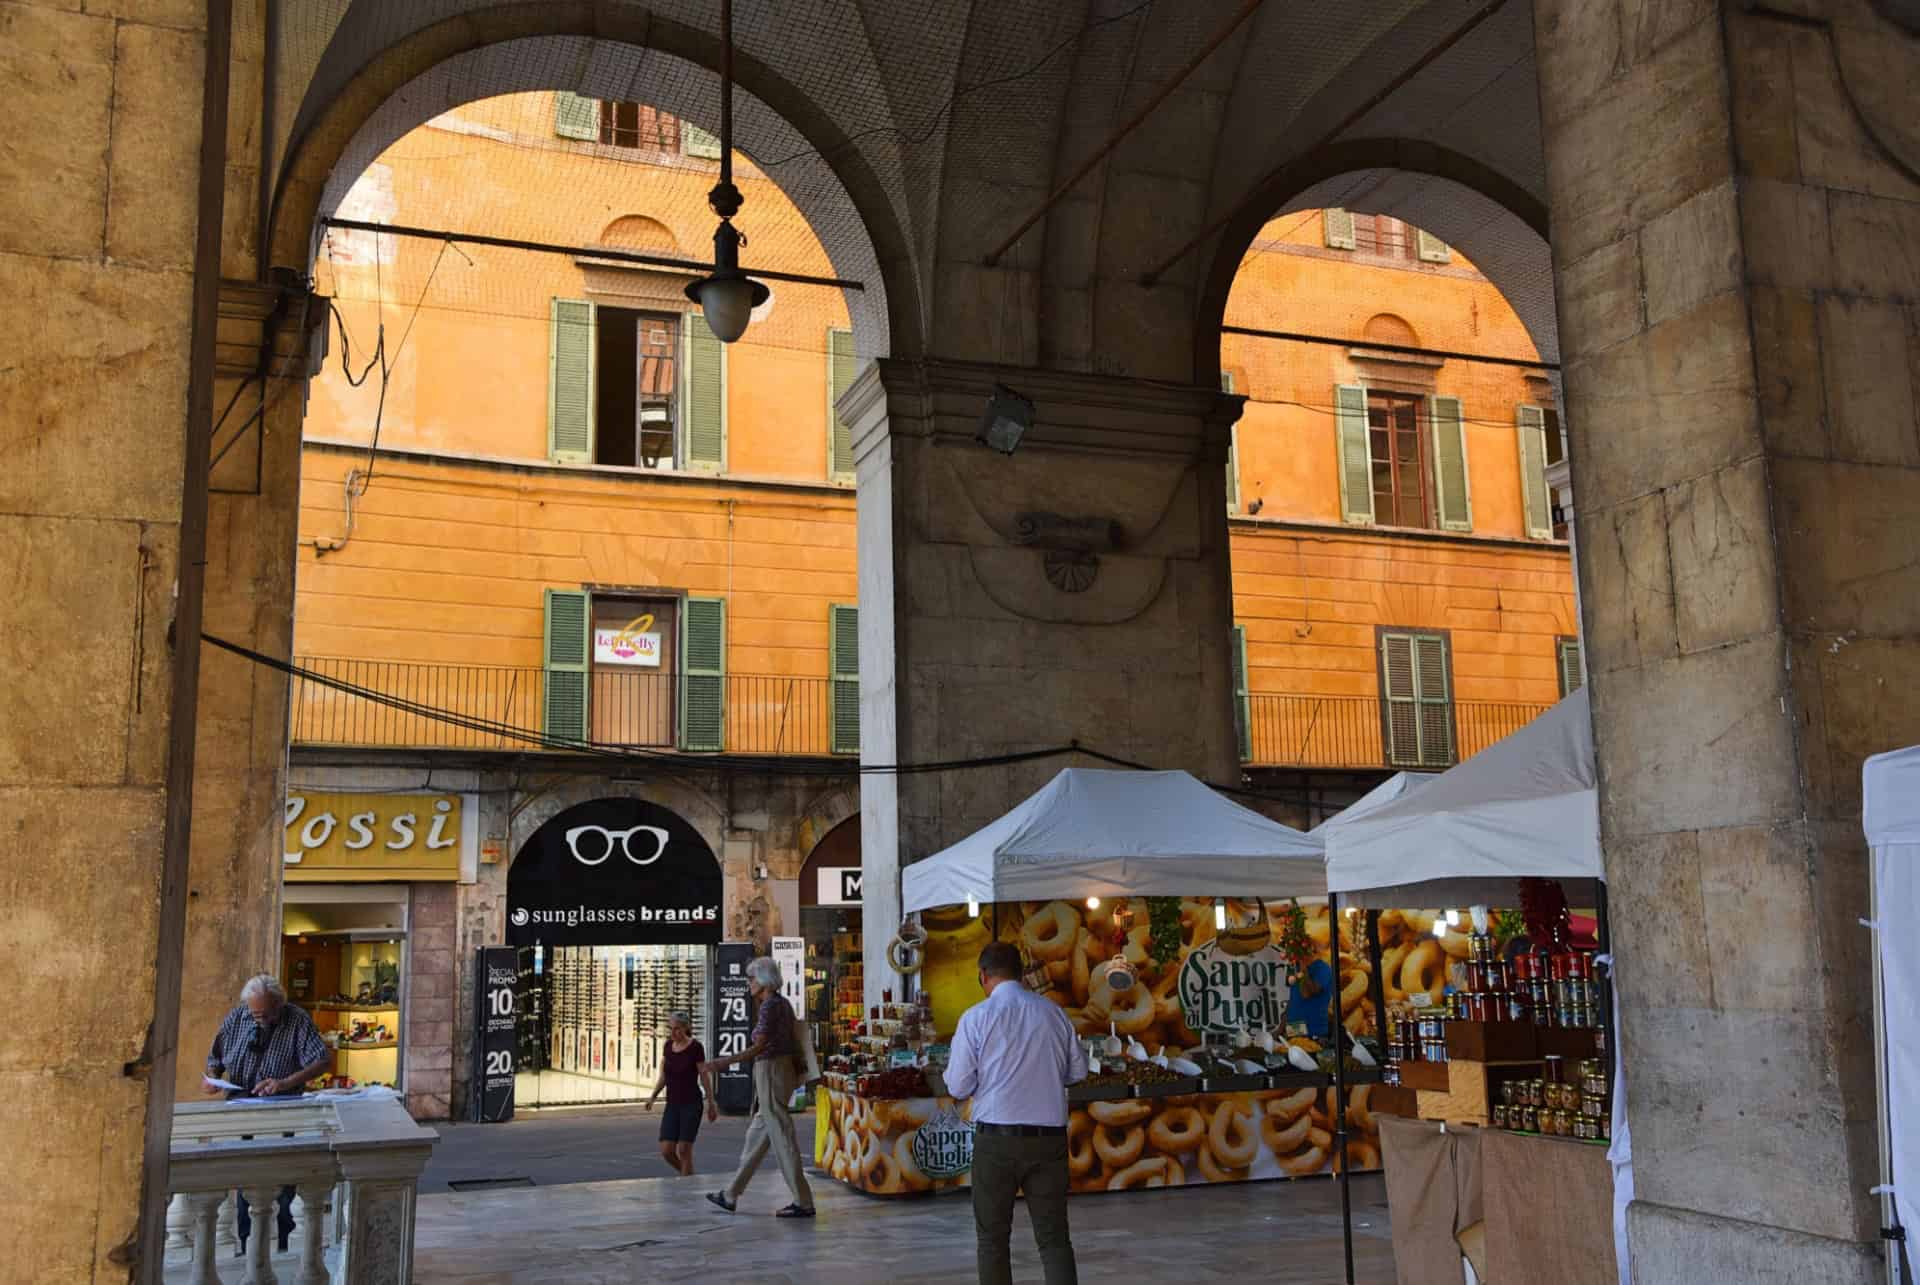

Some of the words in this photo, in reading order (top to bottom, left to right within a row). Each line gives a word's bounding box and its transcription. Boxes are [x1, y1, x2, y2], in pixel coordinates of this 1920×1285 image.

[532, 905, 636, 927] sunglasses
[641, 905, 717, 921] brands
[488, 976, 517, 985] PROMO
